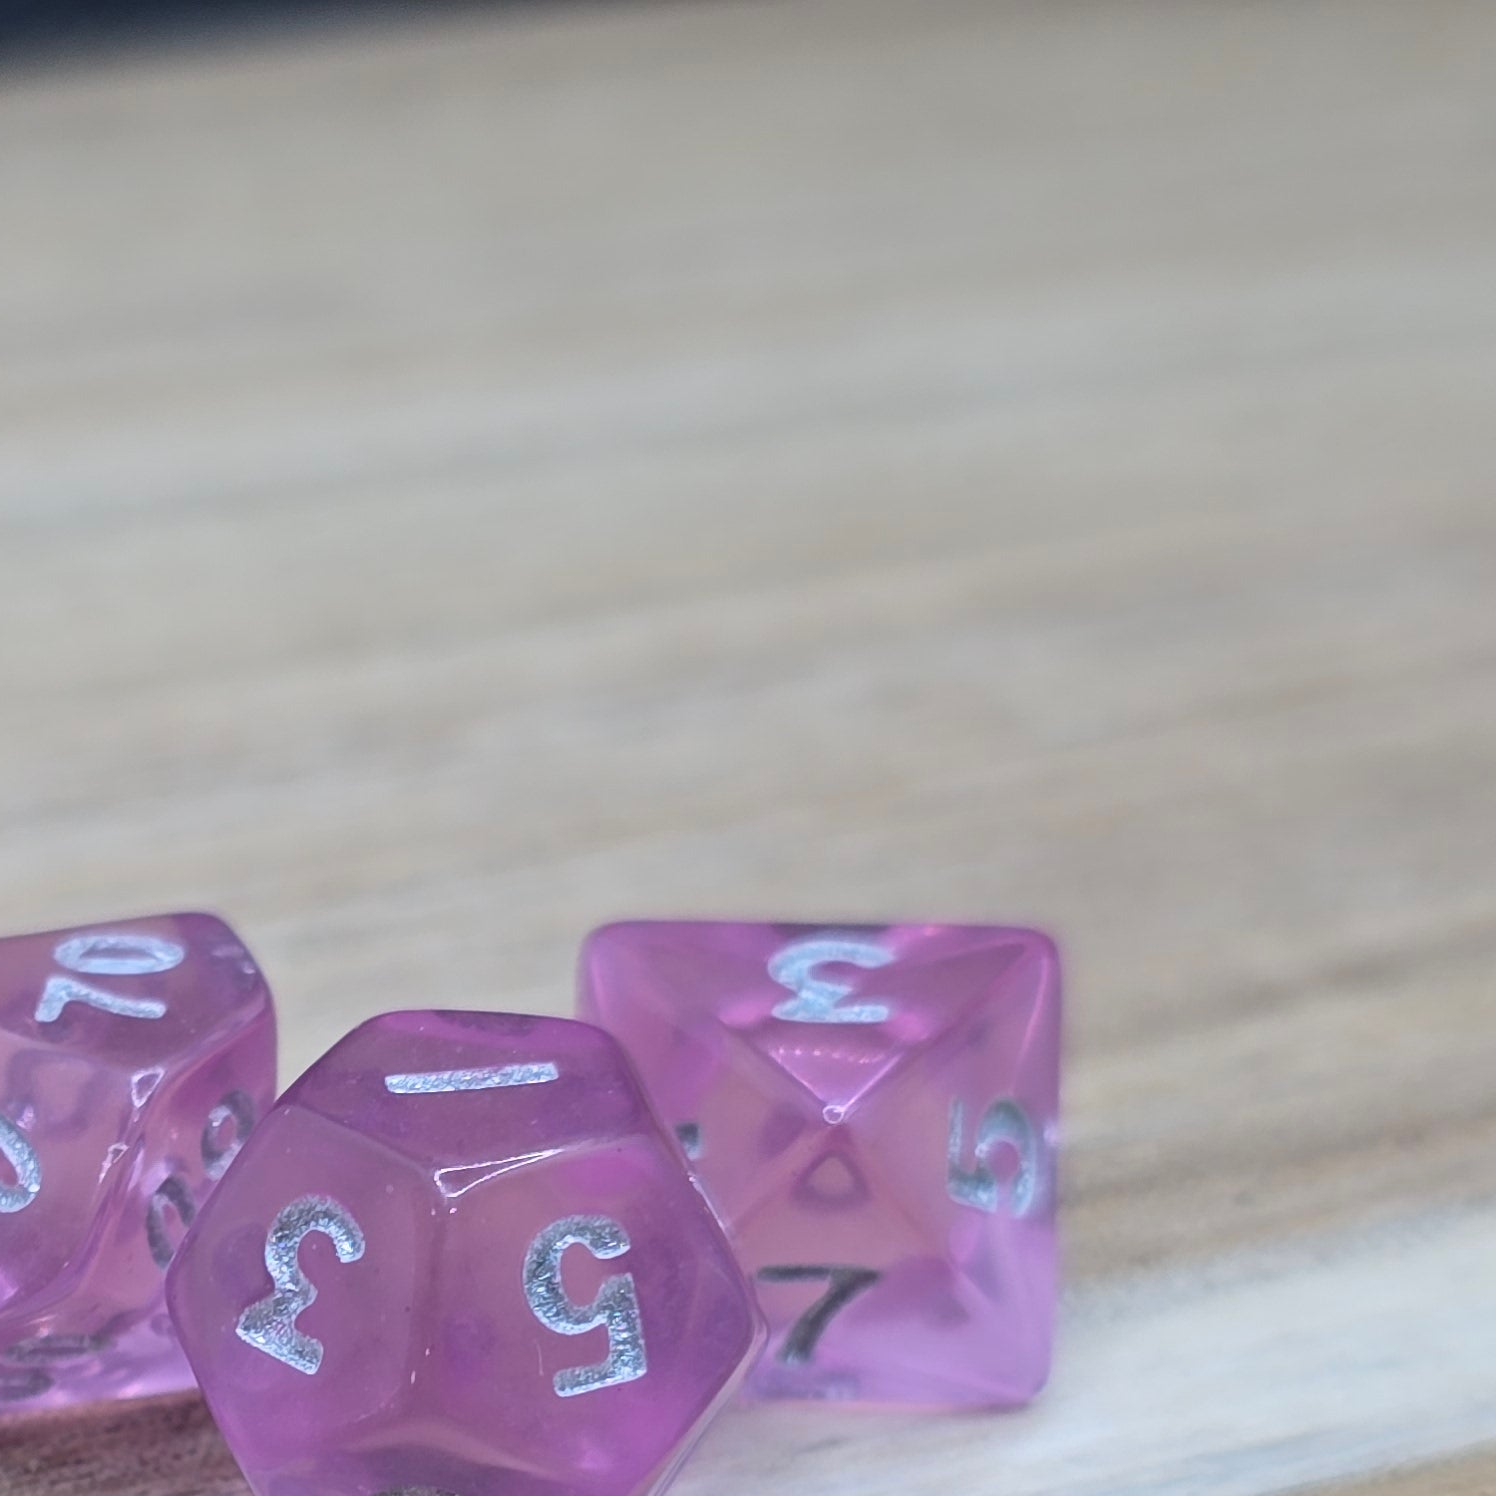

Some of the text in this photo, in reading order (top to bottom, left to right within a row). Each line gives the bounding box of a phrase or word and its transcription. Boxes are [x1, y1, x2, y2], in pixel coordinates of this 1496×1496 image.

[35, 934, 186, 1024] 70
[767, 939, 896, 1024] 3
[236, 1196, 366, 1376] 3
[523, 1214, 647, 1398] 5
[755, 1262, 886, 1369] 7
